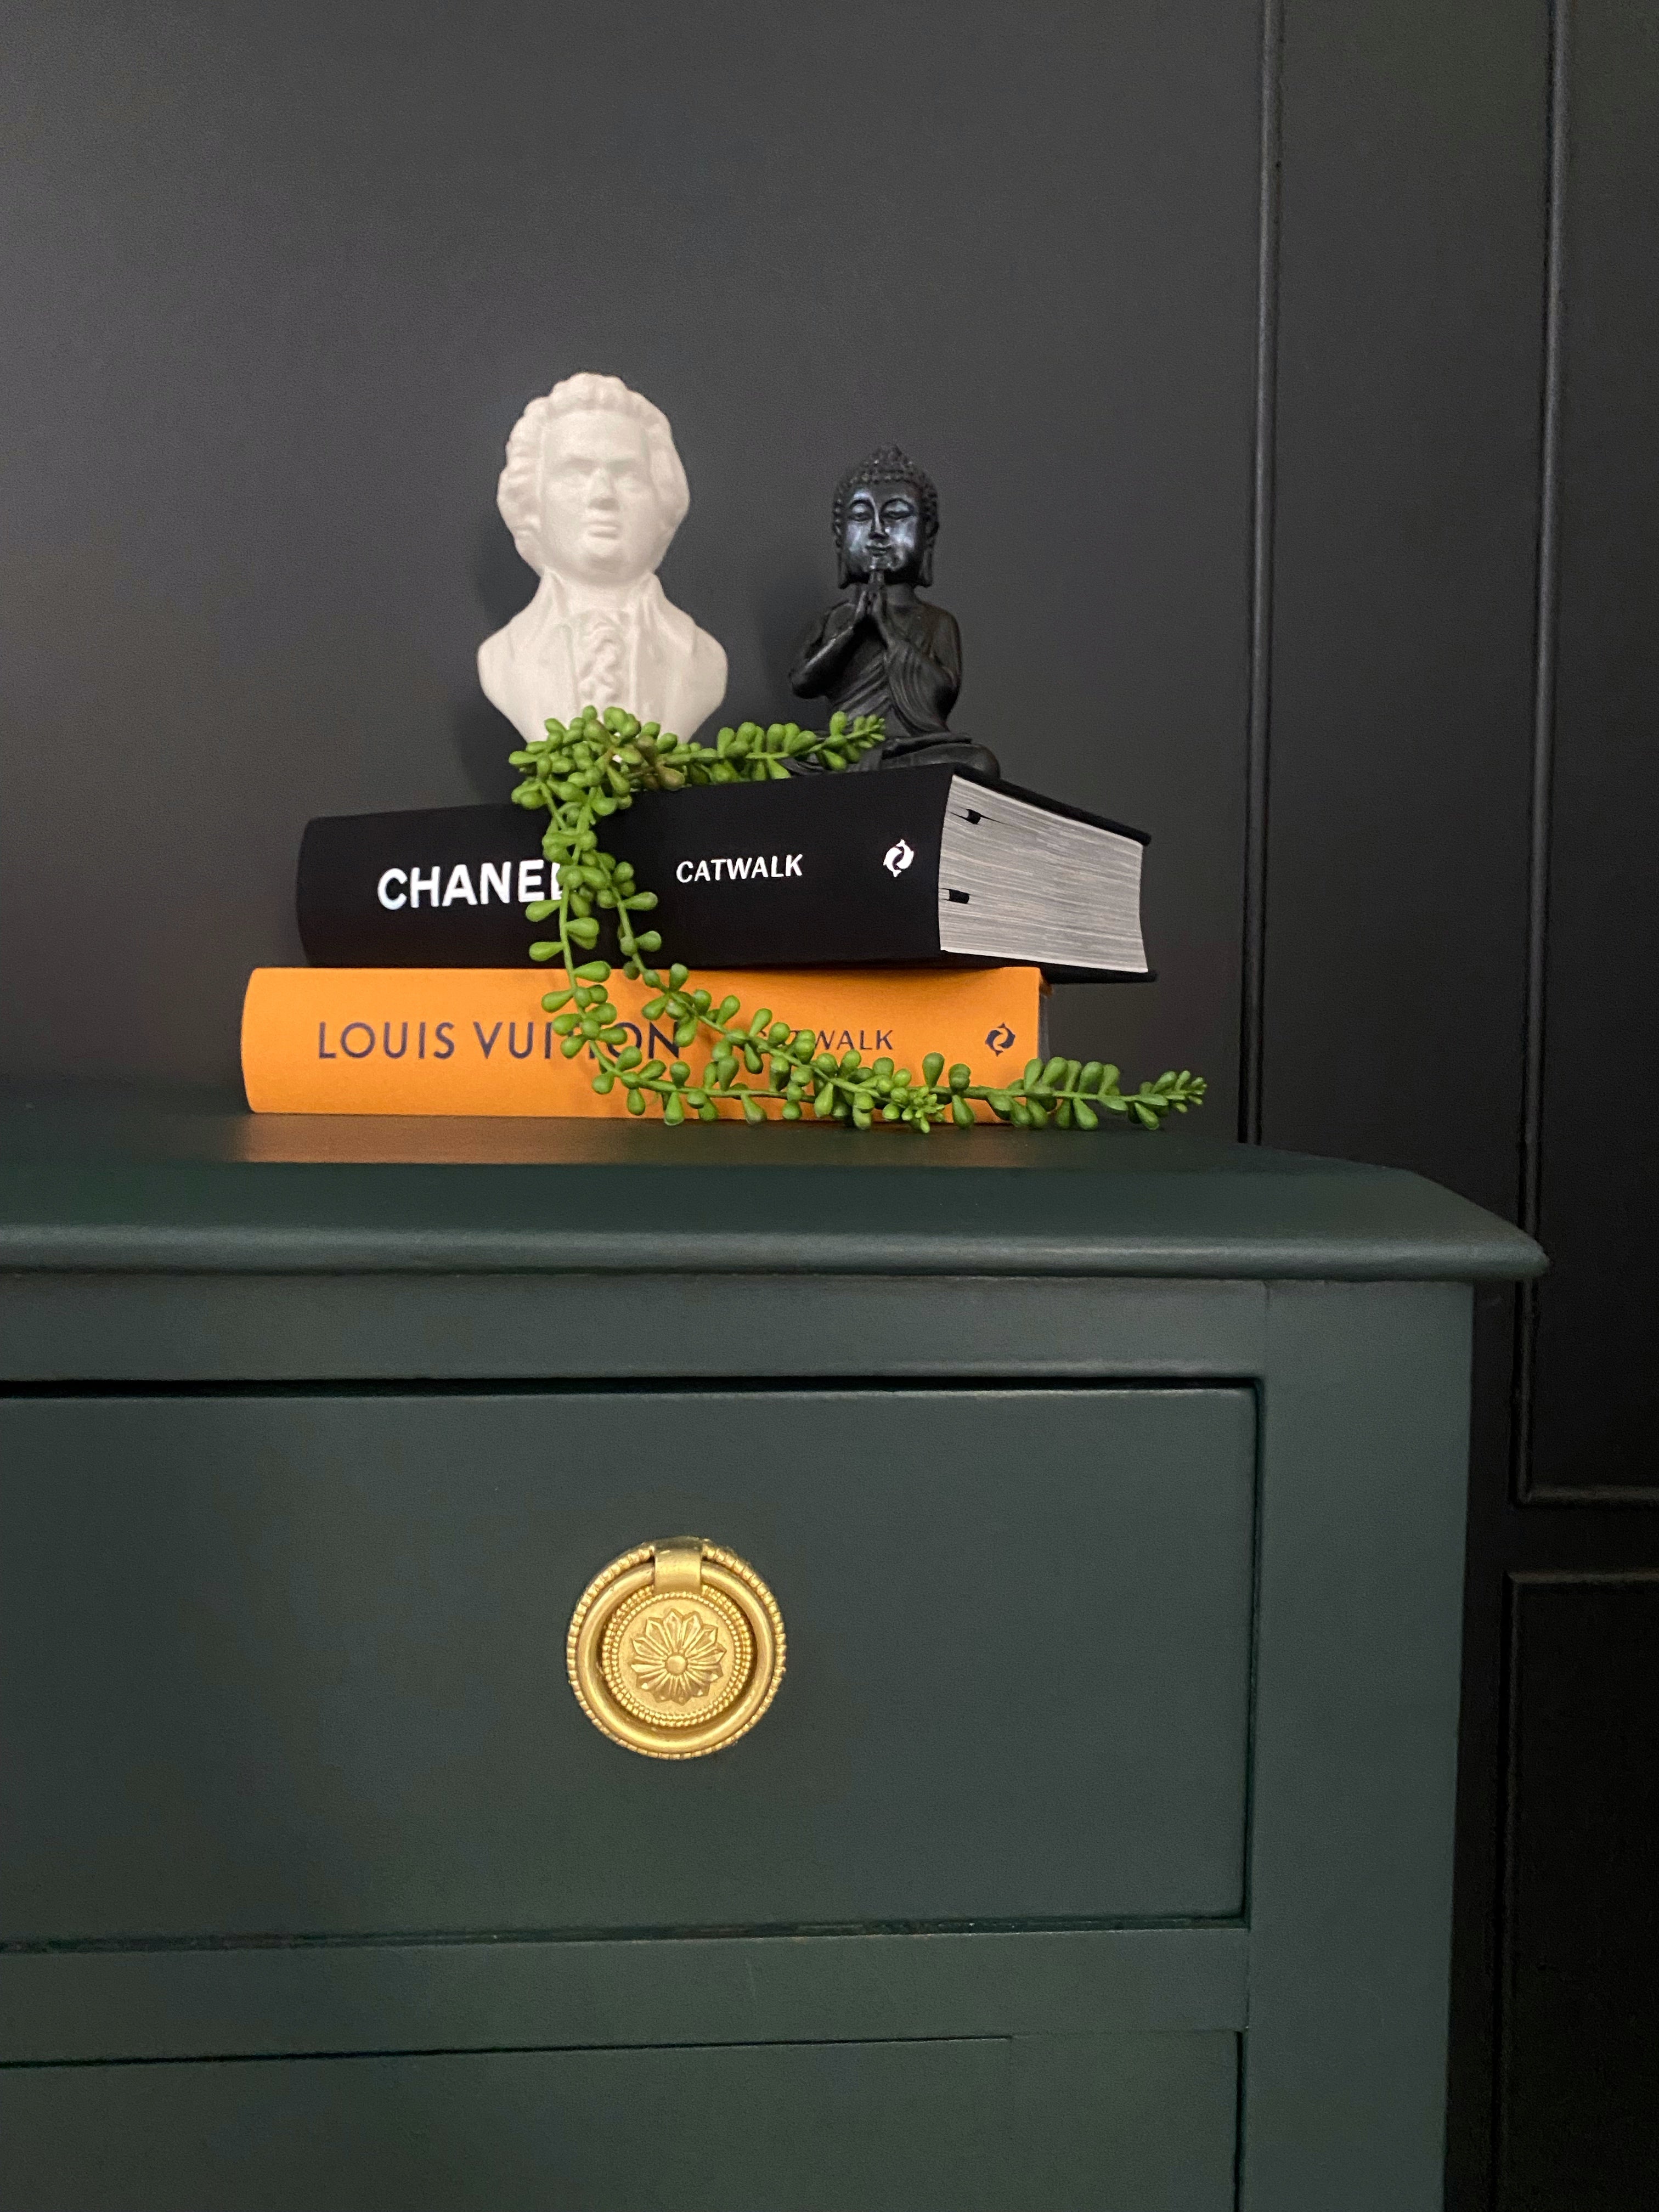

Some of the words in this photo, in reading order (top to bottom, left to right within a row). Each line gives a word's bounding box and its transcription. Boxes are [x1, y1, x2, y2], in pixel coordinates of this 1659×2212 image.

[676, 854, 803, 883] CATWALK
[319, 1022, 454, 1059] LOUIS
[473, 1022, 680, 1059] VUION
[760, 1030, 893, 1050] WALK
